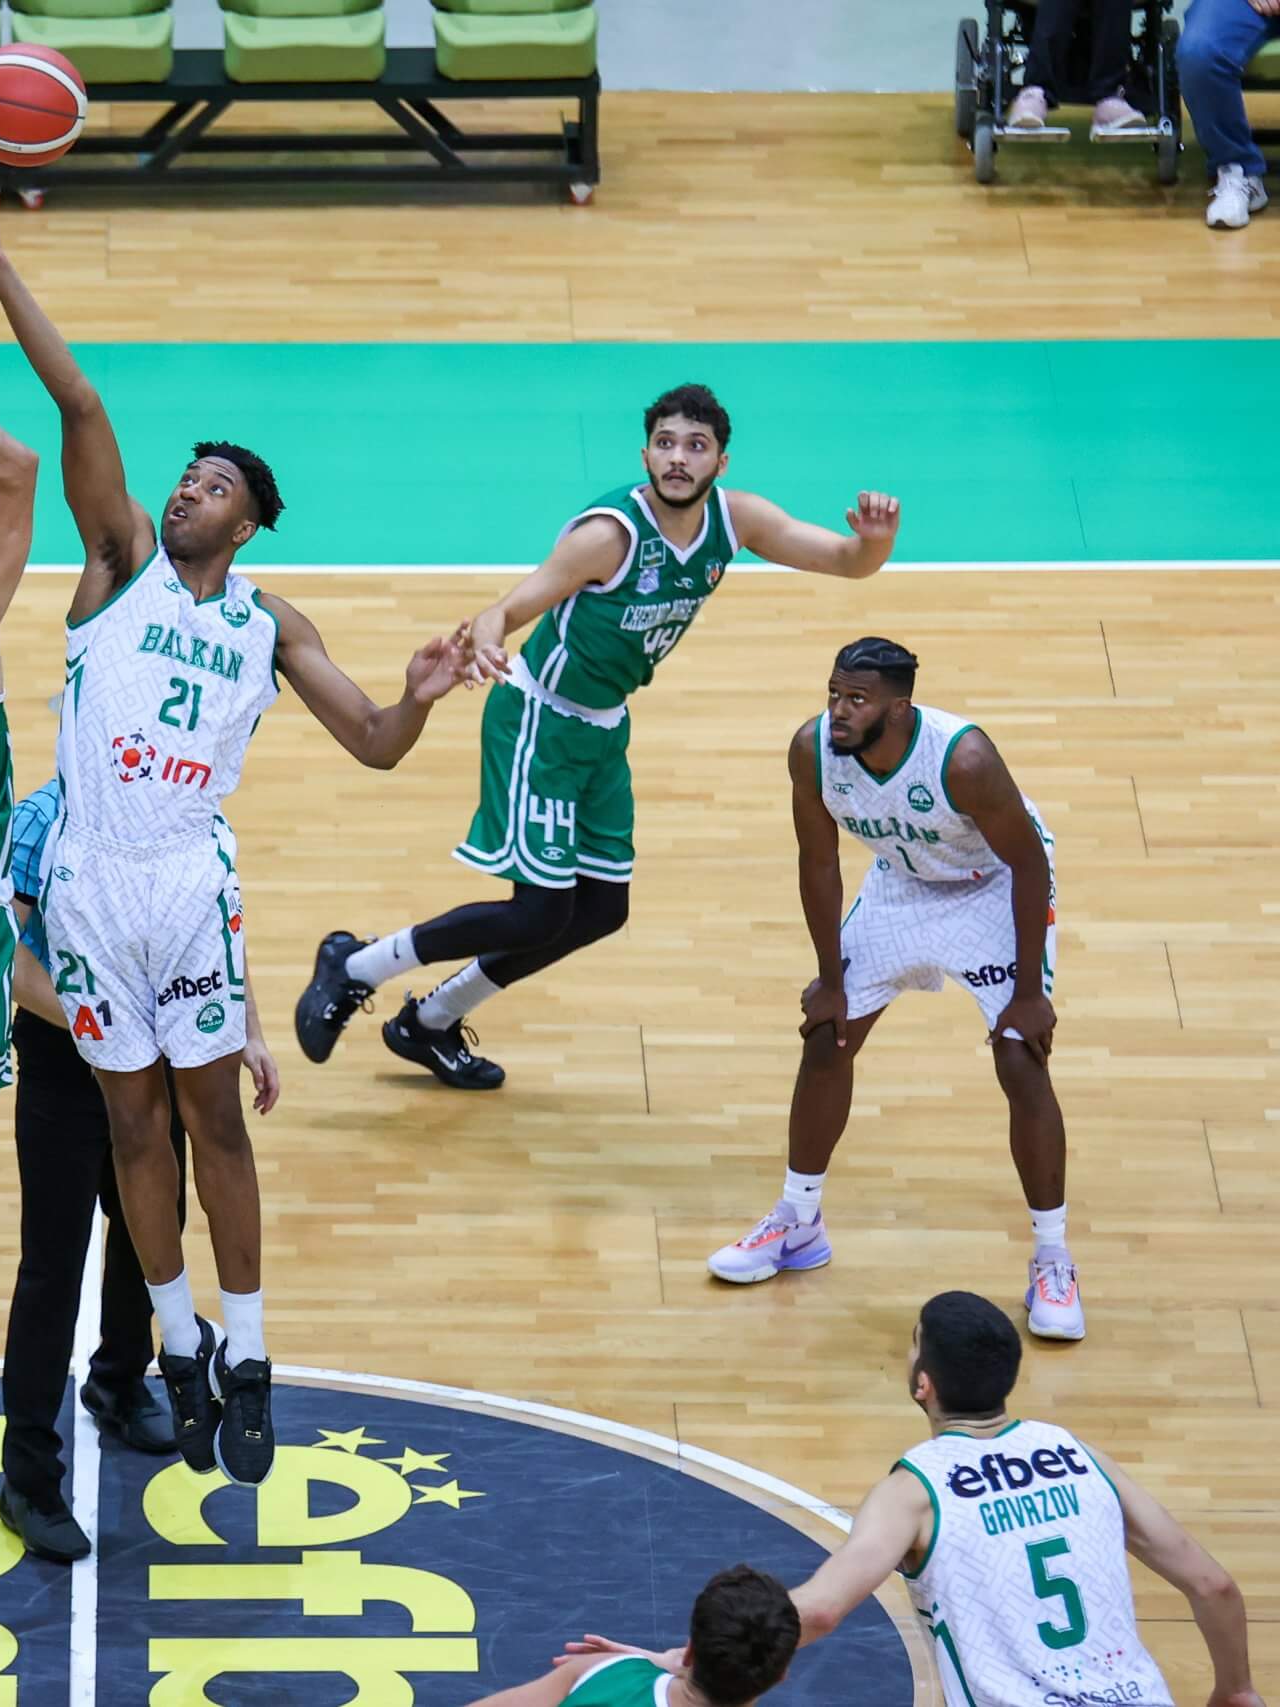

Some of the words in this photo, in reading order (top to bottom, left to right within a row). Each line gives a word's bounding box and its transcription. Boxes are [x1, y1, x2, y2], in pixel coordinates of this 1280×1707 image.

[137, 624, 244, 683] BALKAN
[158, 676, 204, 732] 21
[528, 794, 576, 847] 44
[895, 844, 919, 874] 1
[54, 949, 97, 996] 21
[157, 969, 223, 1007] efbet
[962, 961, 1016, 988] efbe
[73, 999, 113, 1041] A1
[948, 1444, 1089, 1498] efbet
[978, 1483, 1080, 1536] GAVAZOV
[1025, 1534, 1088, 1650] 5
